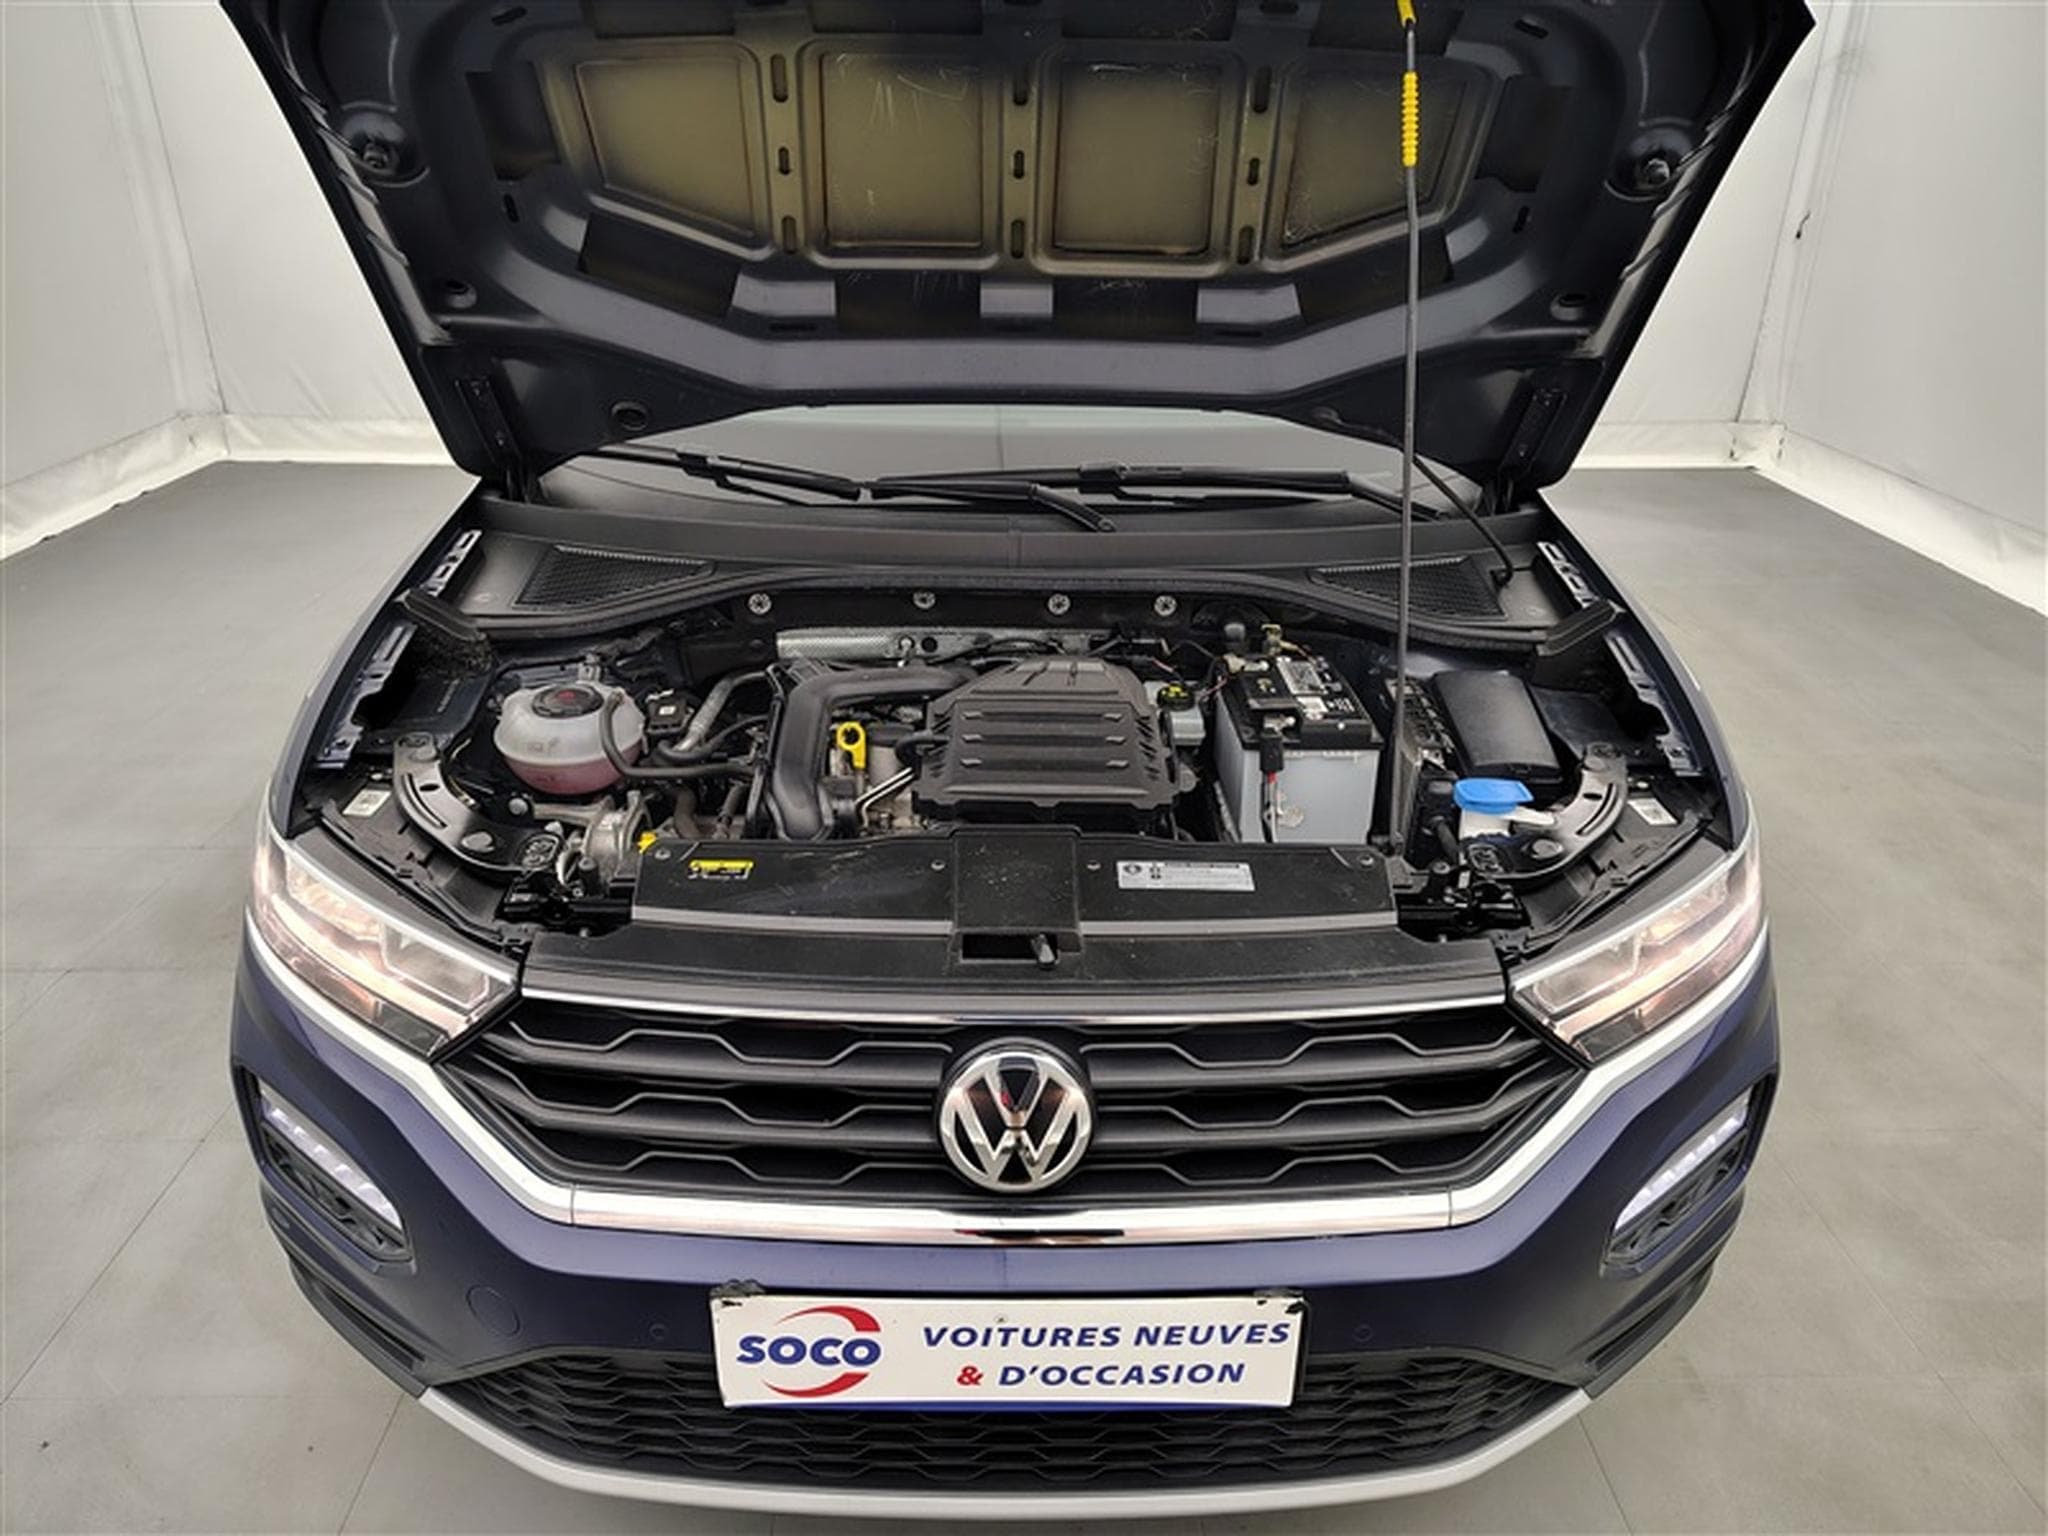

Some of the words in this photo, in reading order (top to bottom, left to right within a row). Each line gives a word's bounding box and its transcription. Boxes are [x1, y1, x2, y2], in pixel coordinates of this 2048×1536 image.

[923, 1326, 1121, 1348] VOITURES
[1134, 1323, 1291, 1347] NEUVES
[736, 1335, 882, 1367] SOCO
[956, 1365, 982, 1386] &
[999, 1363, 1246, 1387] D'OCCASION
